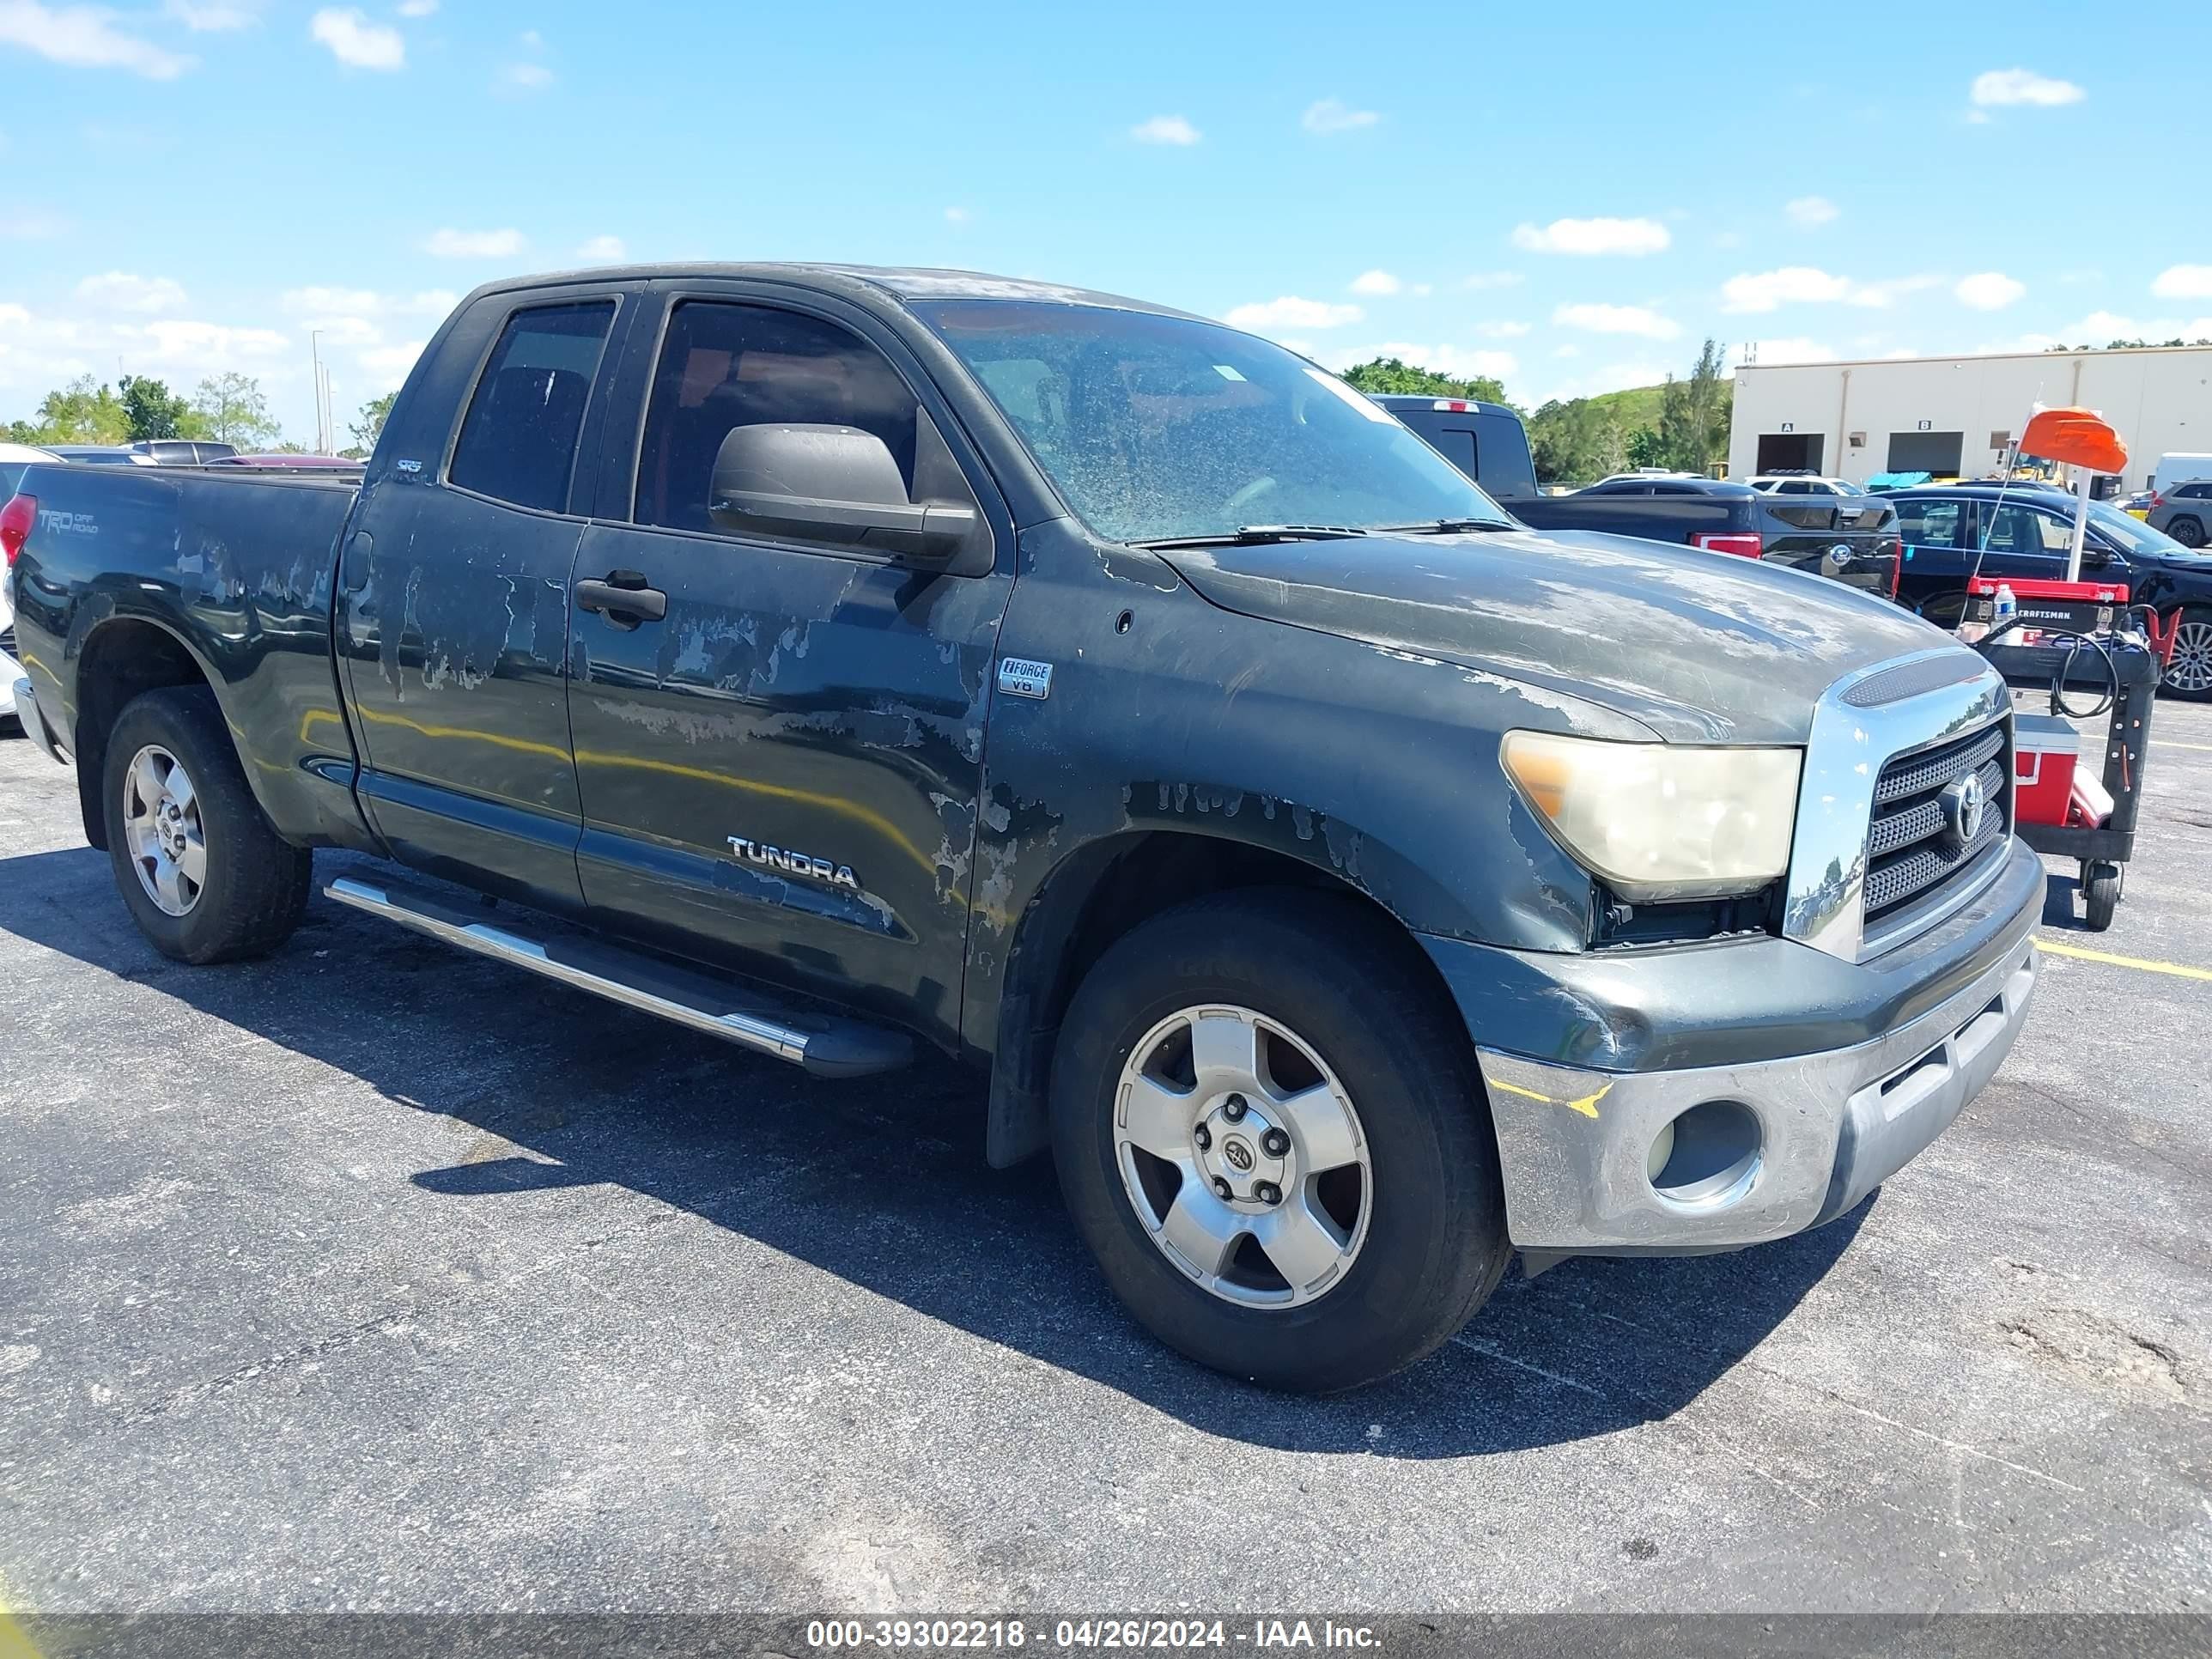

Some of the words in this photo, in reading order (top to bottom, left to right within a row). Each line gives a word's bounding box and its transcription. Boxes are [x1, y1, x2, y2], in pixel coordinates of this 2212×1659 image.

[38, 509, 73, 534] TRD
[74, 514, 94, 522] OFF
[72, 523, 99, 533] ROAD
[2018, 610, 2071, 620] CRAFTSMAN
[1012, 680, 1032, 692] V8
[726, 836, 858, 889] TUNDRA
